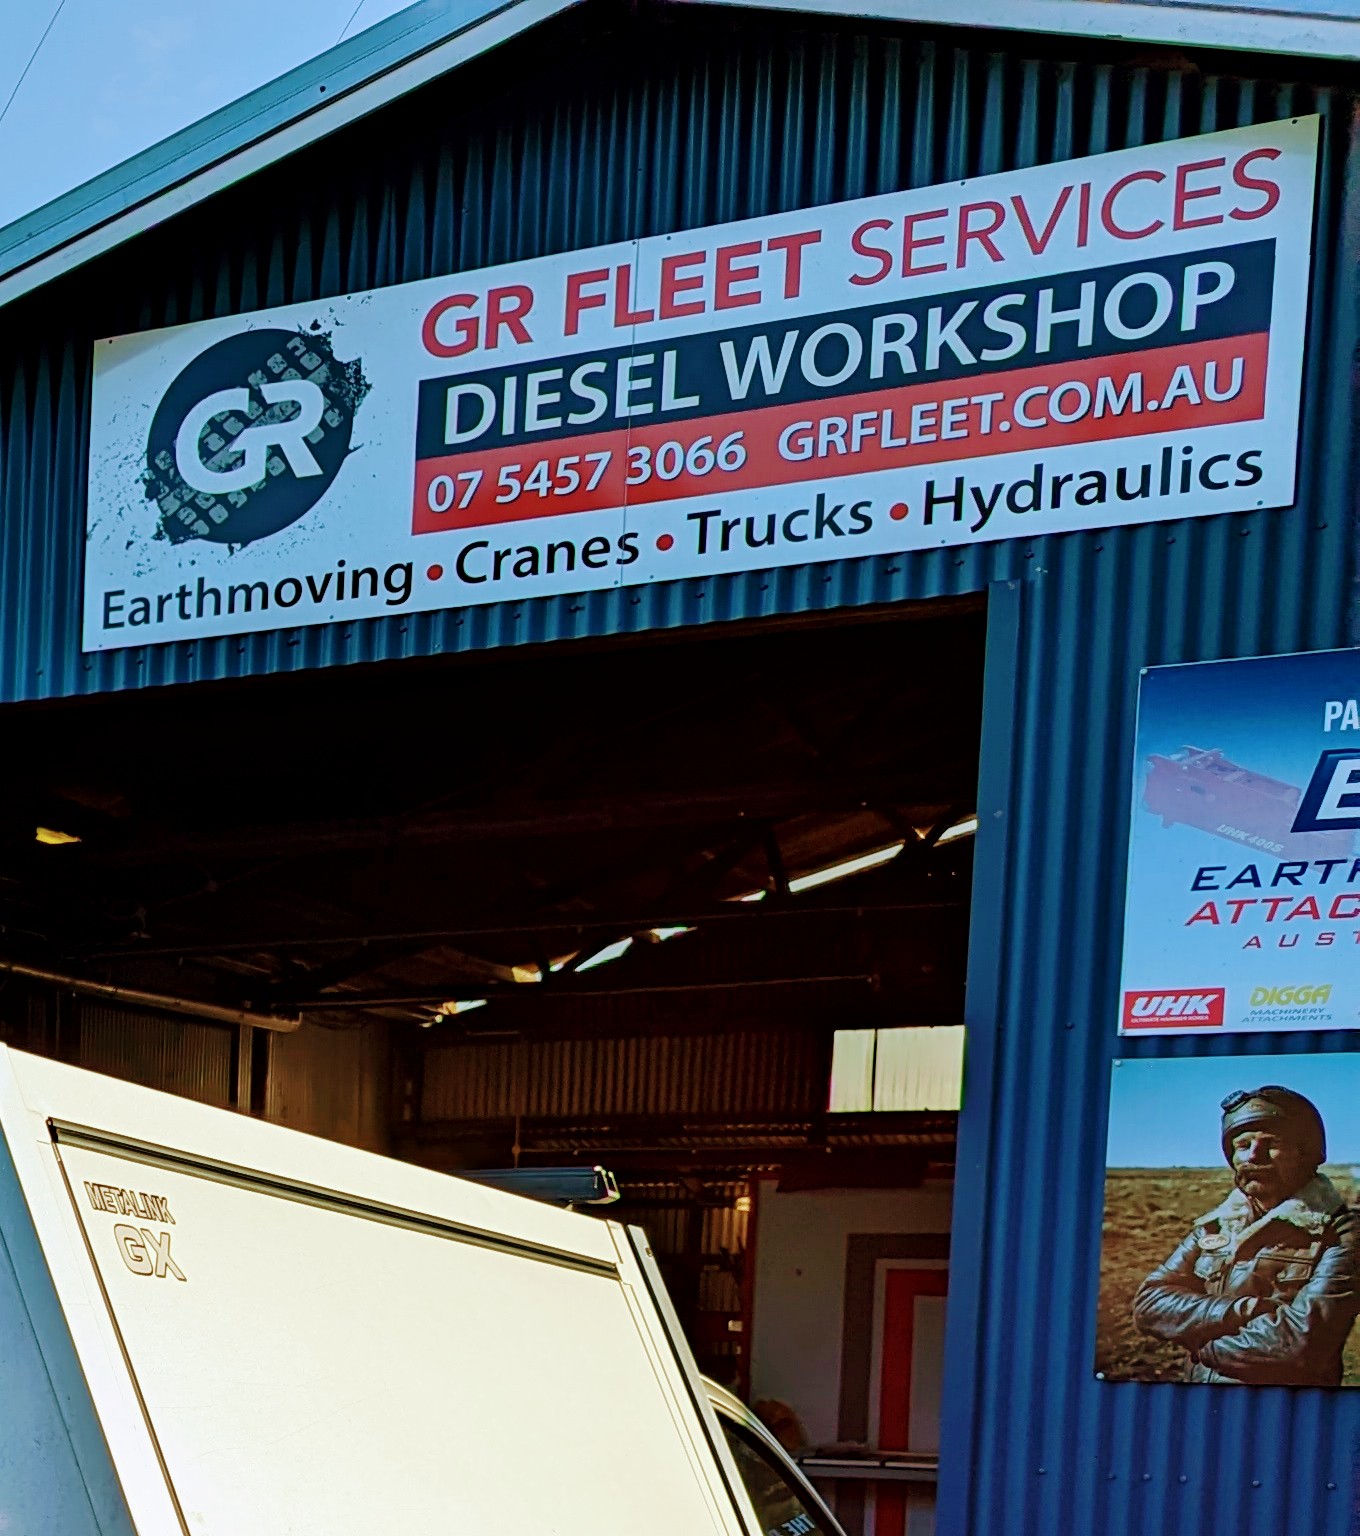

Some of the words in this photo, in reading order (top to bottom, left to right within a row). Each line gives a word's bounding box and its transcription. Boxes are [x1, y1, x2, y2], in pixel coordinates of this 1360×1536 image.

[421, 284, 535, 361] GR
[563, 230, 822, 336] FLEET
[849, 147, 1282, 287] SERVICES
[444, 346, 700, 447] DIESEL
[720, 260, 1237, 402] WORKSHOP
[173, 379, 327, 498] GR
[427, 470, 484, 515] 07
[493, 451, 613, 507] 5457
[625, 431, 747, 487] 3066
[778, 358, 1246, 463] GRFLEET.COM.AU
[101, 557, 415, 632] Earthmoving
[455, 530, 640, 586] Cranes
[687, 493, 874, 557] Trucks
[924, 441, 1264, 535] Hydraulics
[1131, 995, 1219, 1016] UHK
[1241, 1015, 1332, 1023] ATTACHMENTS
[1250, 984, 1333, 1006] DIGGA
[84, 1181, 176, 1225] METALINK
[114, 1224, 187, 1282] GX
